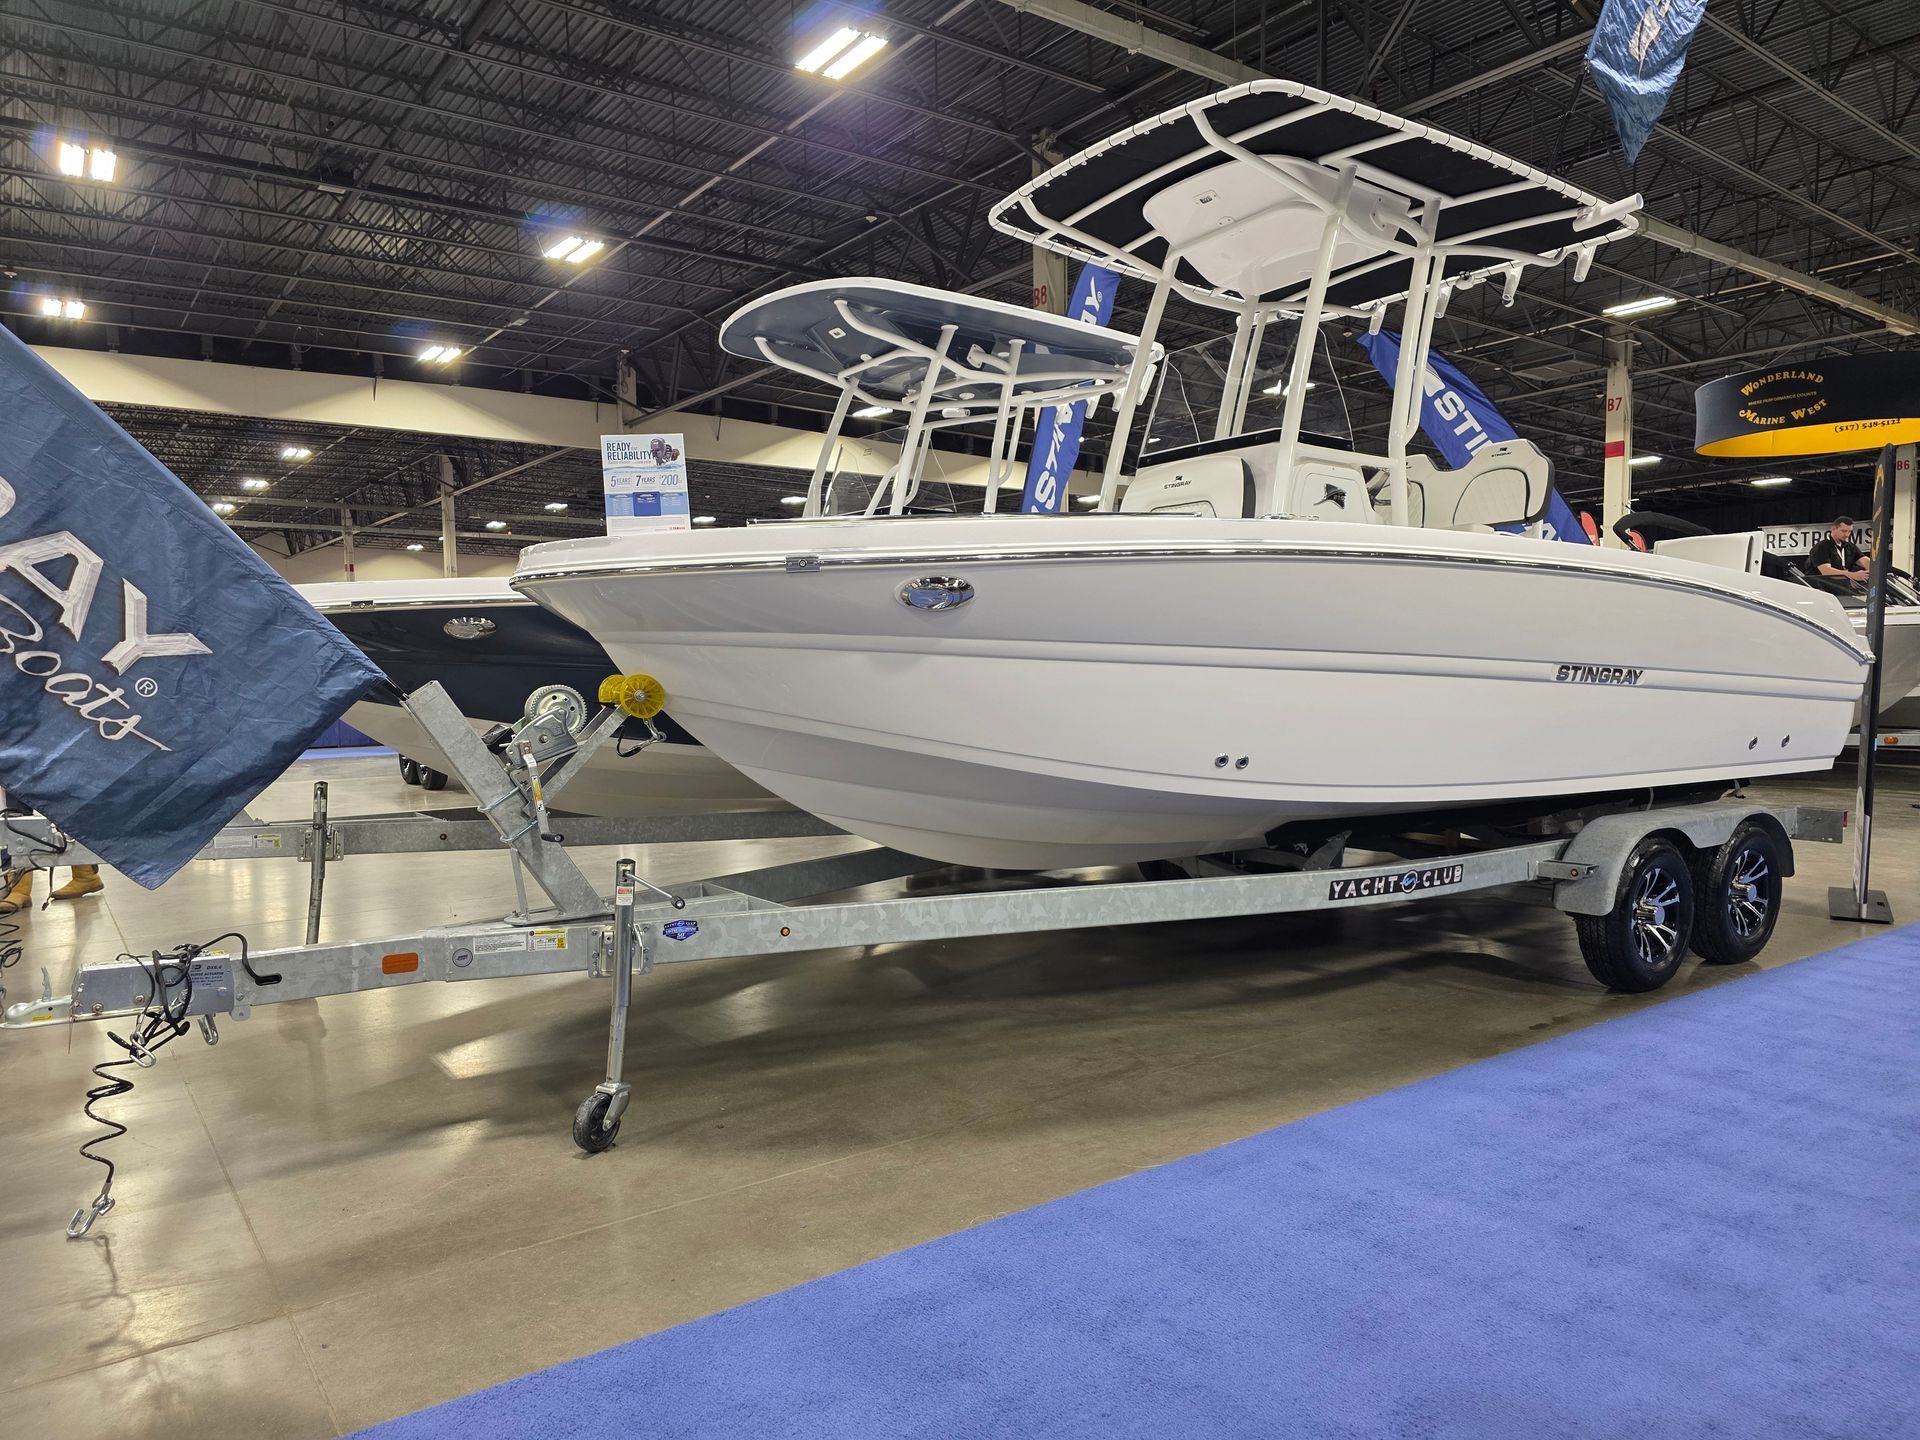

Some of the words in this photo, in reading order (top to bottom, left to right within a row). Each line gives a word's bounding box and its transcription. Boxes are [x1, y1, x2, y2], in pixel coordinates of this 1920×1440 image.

[1033, 285, 1047, 307] B8
[1740, 371, 1825, 397] WONDERLAND
[1607, 397, 1622, 411] B7
[1738, 409, 1786, 425] MARINE
[1791, 399, 1827, 420] WEST
[1834, 423, 1859, 433] (517)
[606, 442, 631, 451] READY
[607, 450, 653, 461] RELIABILITY
[1896, 460, 1910, 471] B6
[611, 476, 617, 487] 5
[636, 475, 642, 487] 7
[1556, 665, 1643, 685] STINGRAY
[1332, 875, 1399, 899] YACHT
[1422, 865, 1463, 887] CLUB
